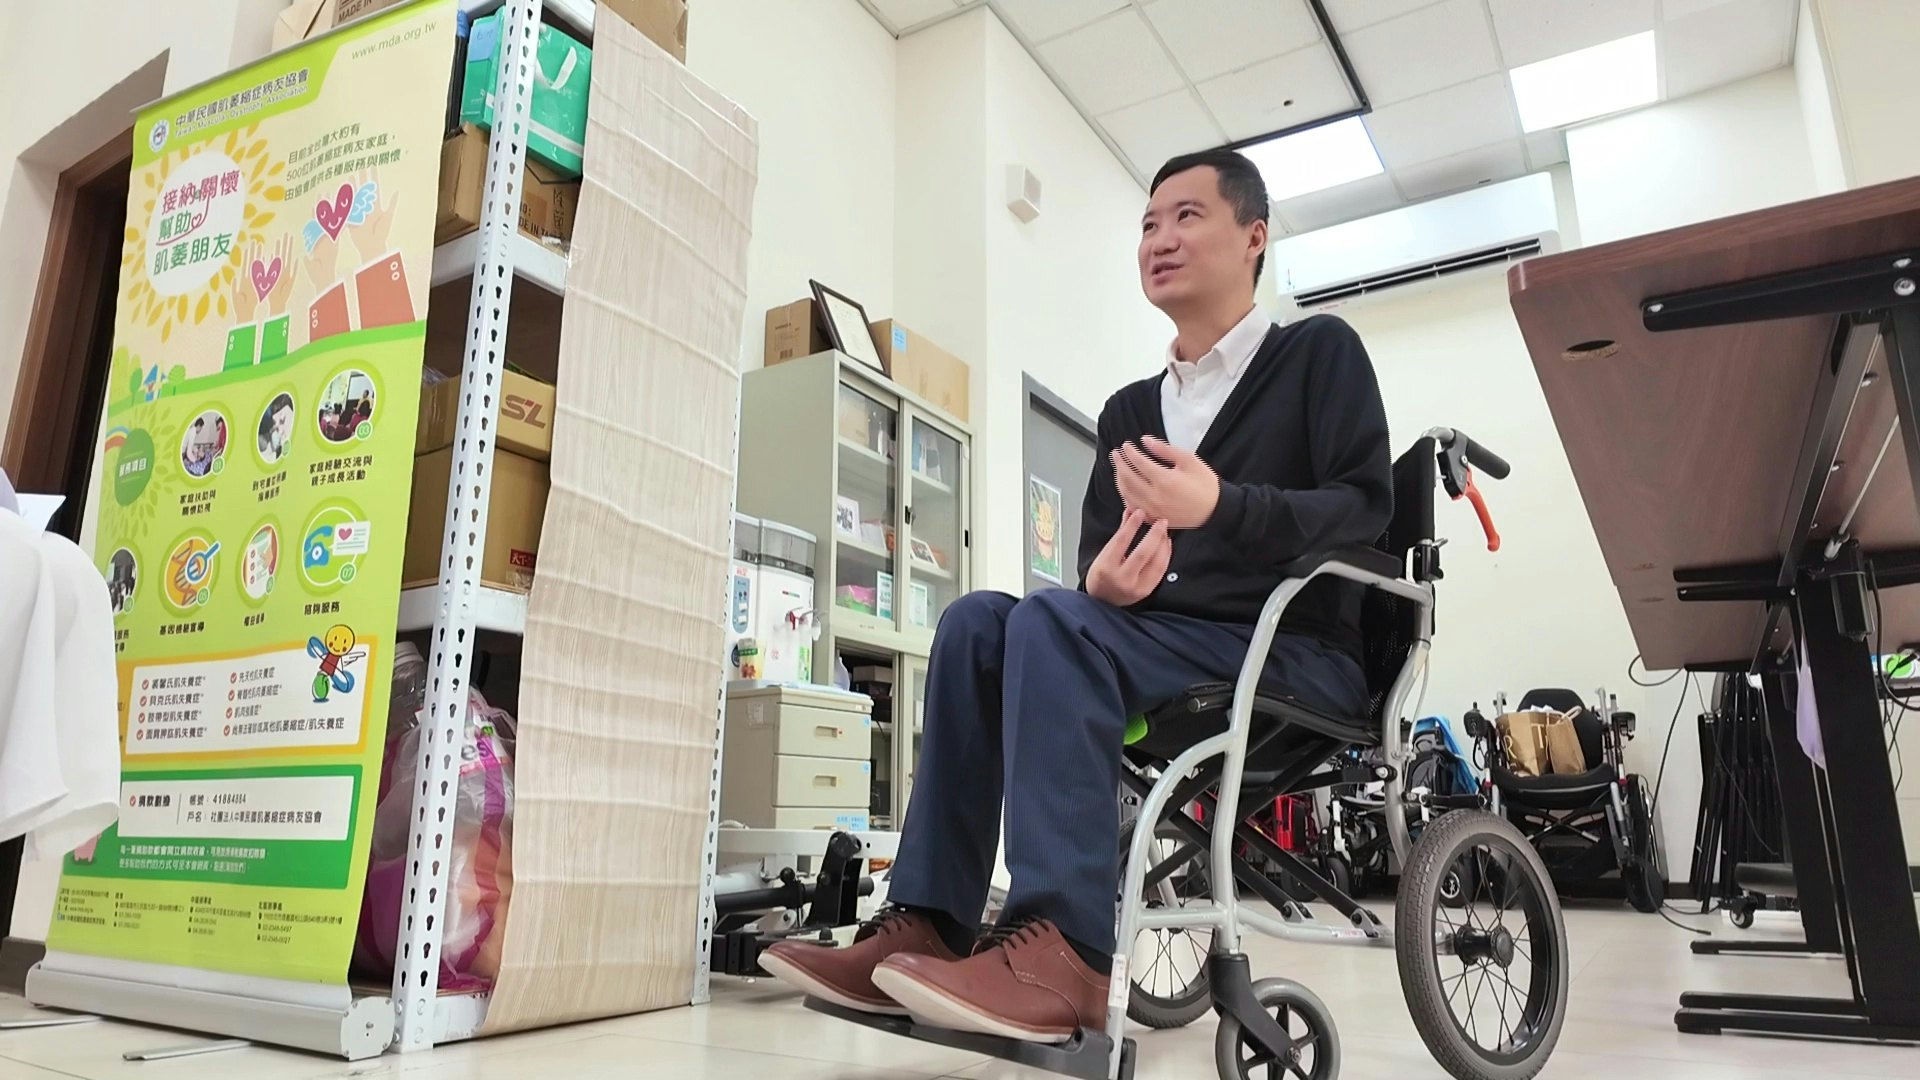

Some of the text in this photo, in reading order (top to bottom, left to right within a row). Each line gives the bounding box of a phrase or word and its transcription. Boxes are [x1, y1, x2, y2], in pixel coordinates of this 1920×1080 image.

[338, 2, 361, 23] MADE
[351, 21, 438, 60] www.mda.org.tw
[175, 69, 309, 127] 中華民國肌萎縮症病友協會
[159, 210, 192, 241] 幫助
[153, 233, 232, 276] 肌萎朋友
[311, 469, 366, 487] 親子成長活動
